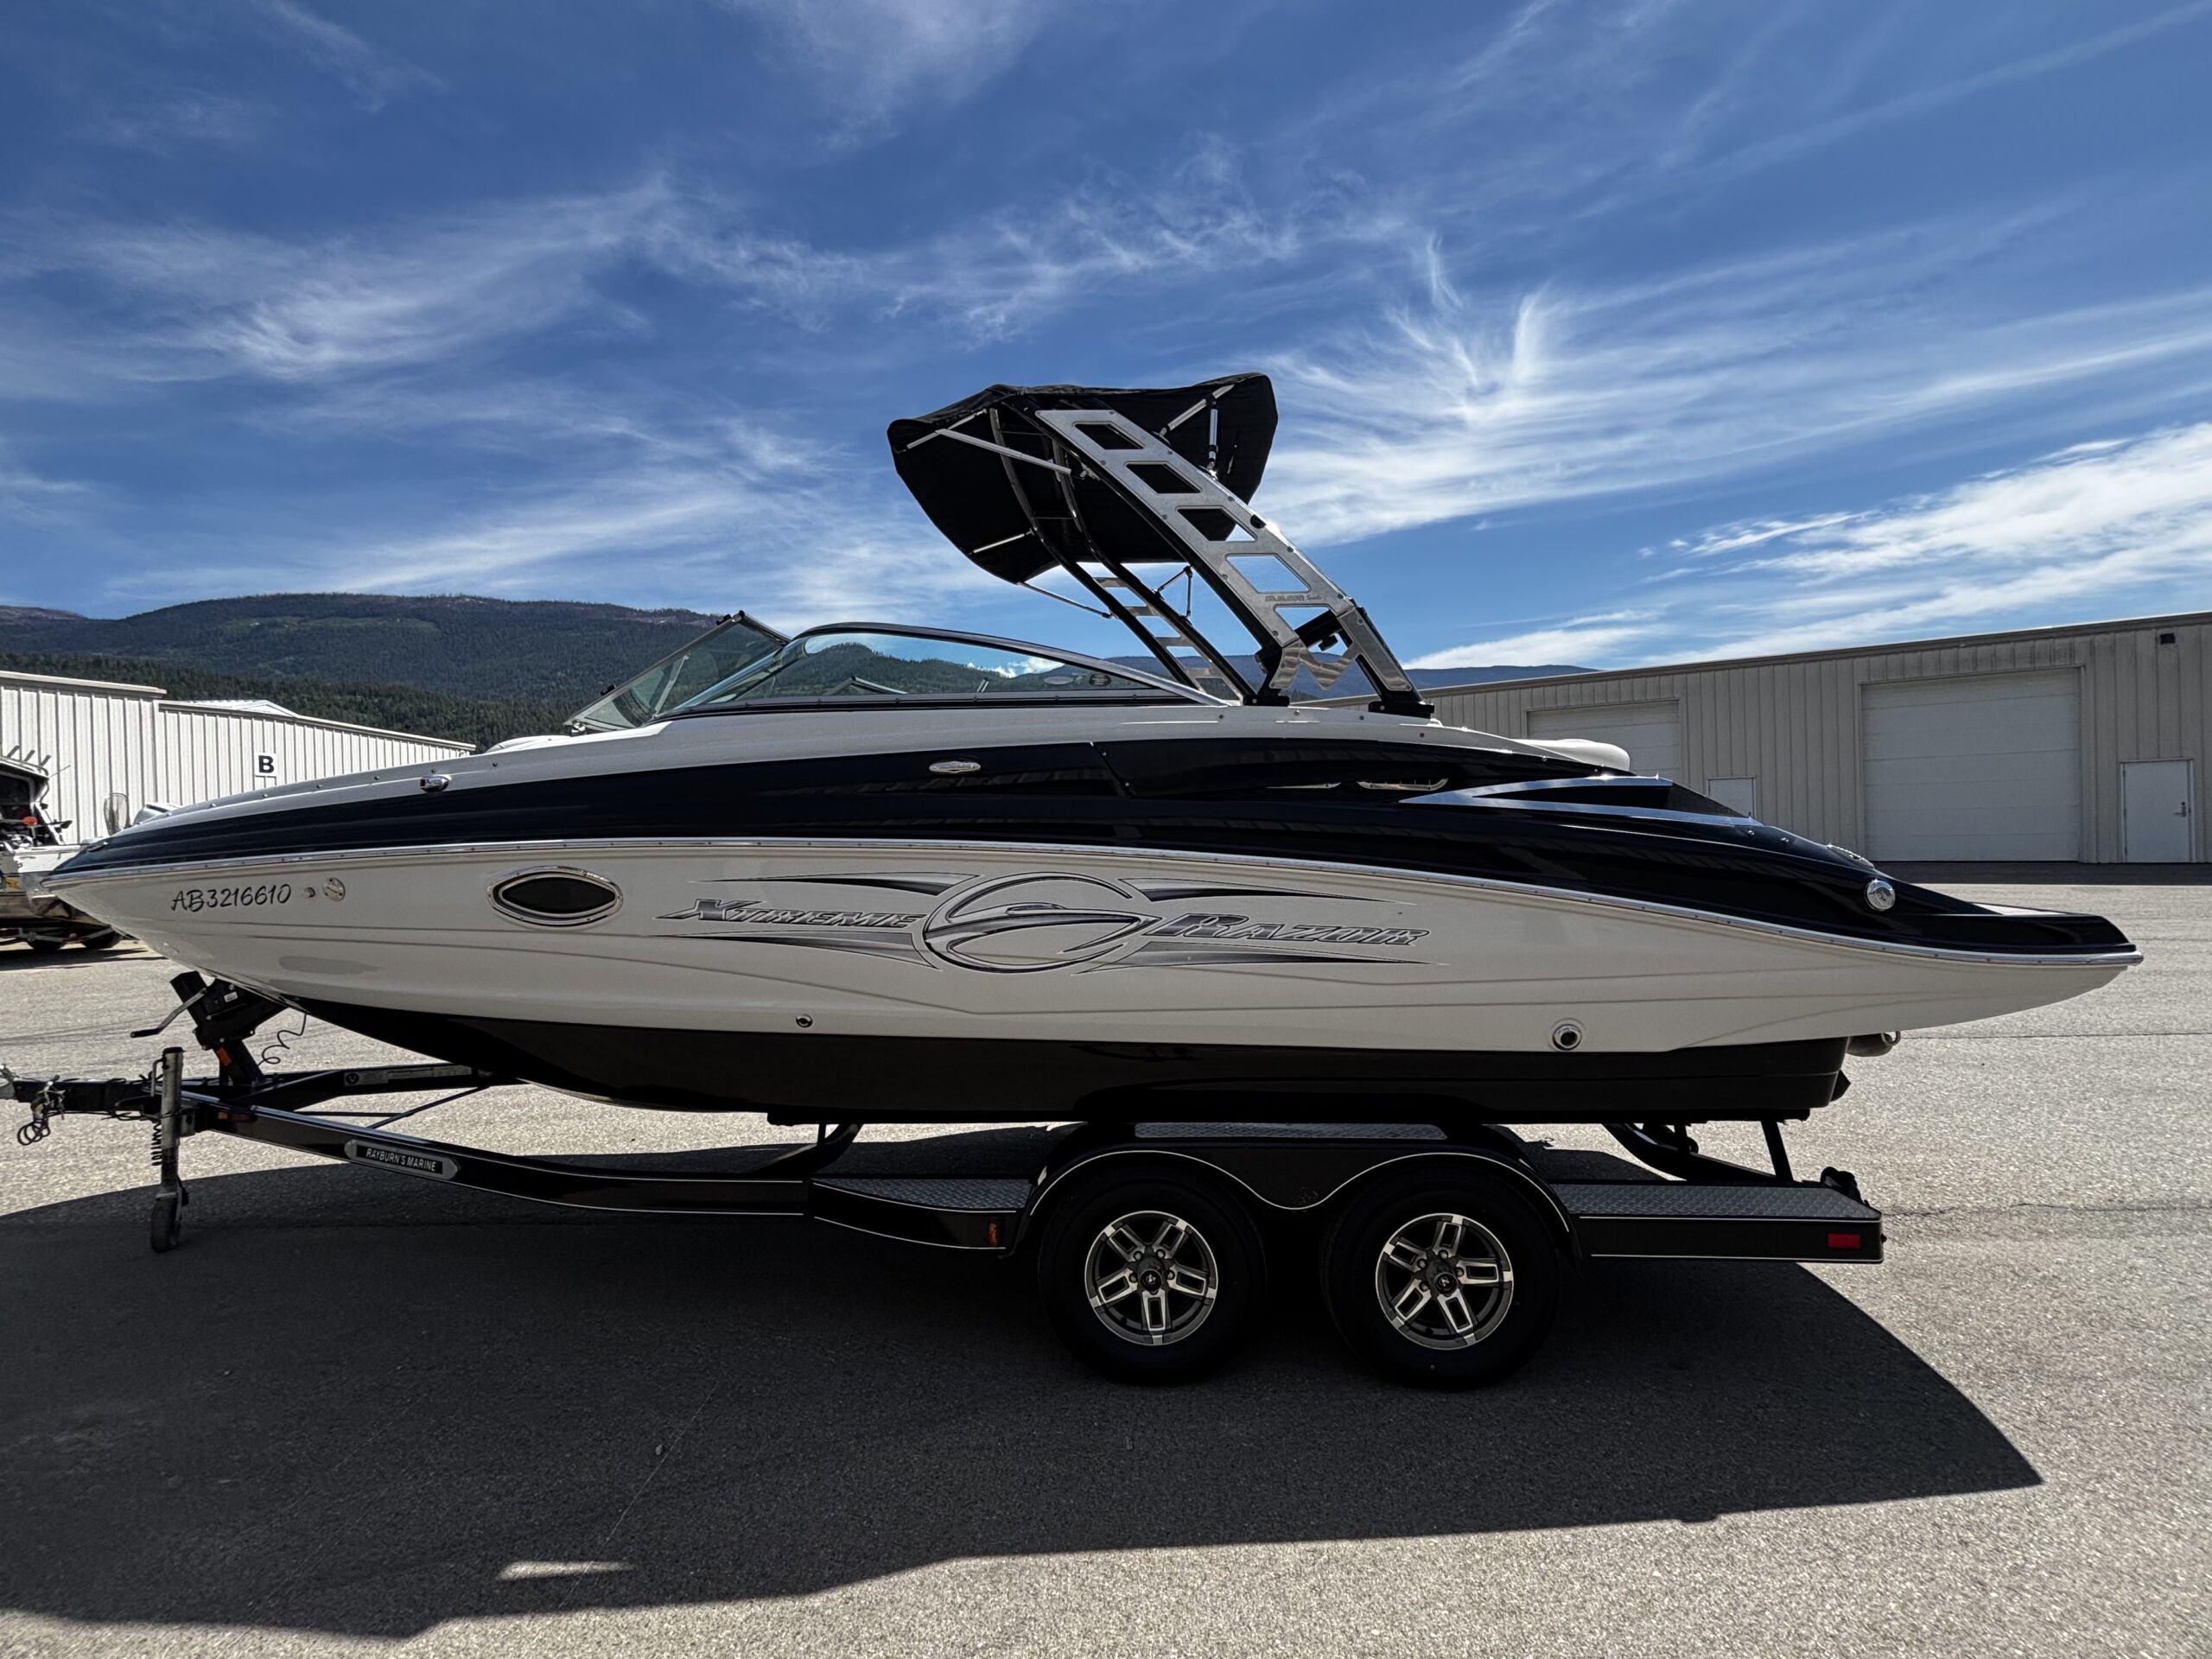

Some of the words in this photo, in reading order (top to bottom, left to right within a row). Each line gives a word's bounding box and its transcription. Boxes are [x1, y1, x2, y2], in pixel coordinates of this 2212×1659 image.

[258, 755, 274, 773] B
[171, 883, 291, 912] AB3216610
[365, 1147, 406, 1165] RAYBURN'S
[406, 1156, 436, 1172] MARINE
